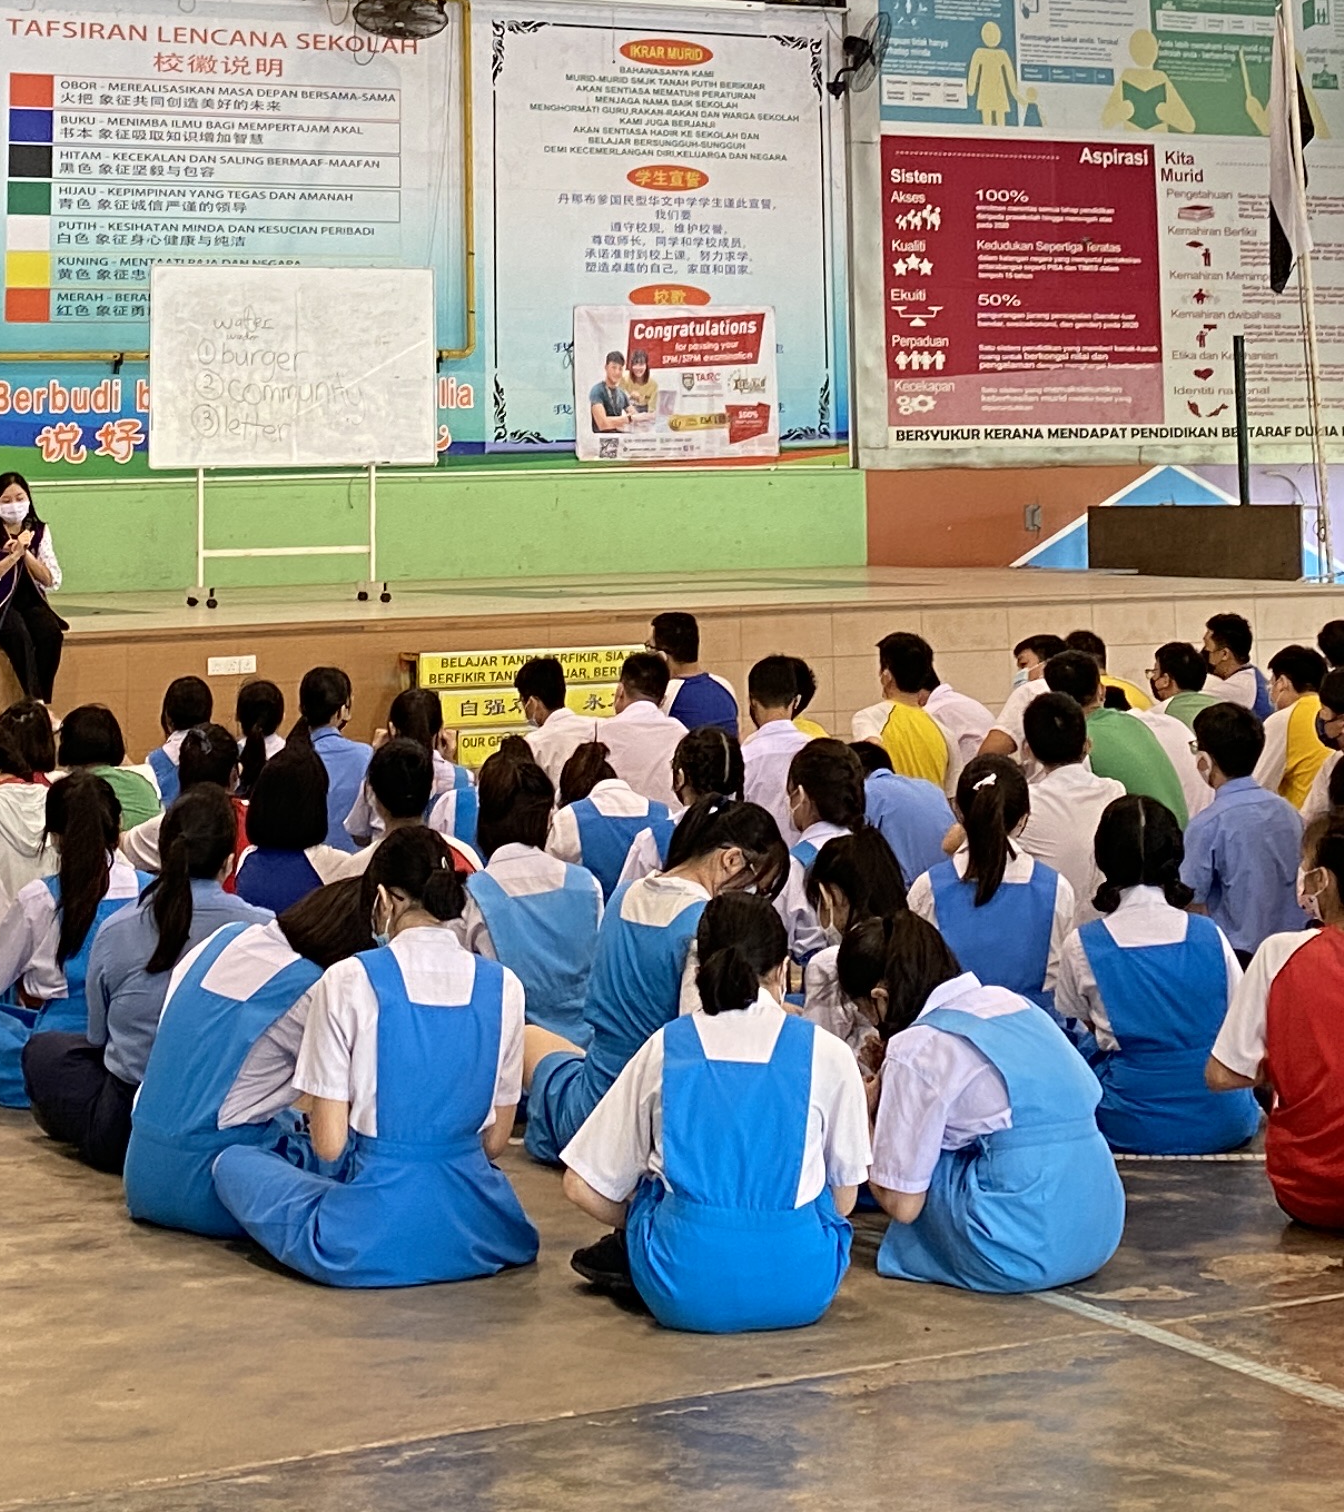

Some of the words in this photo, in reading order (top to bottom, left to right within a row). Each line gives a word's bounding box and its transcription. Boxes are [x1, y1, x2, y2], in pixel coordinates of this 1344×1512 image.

[9, 17, 148, 42] TAFSIRAN
[158, 25, 287, 48] LENCANA
[297, 33, 418, 55] SEKOLAH
[630, 45, 664, 60] IKRAR
[667, 47, 704, 63] MURID
[154, 52, 283, 77] 校徽说明
[60, 115, 95, 125] BUKU
[59, 149, 101, 161] HITAM
[112, 151, 186, 163] KECEKALAN
[1079, 147, 1148, 168] Aspirasi
[1165, 150, 1194, 165] Kita
[891, 168, 942, 184] Sistem
[1160, 167, 1203, 182] Murid
[107, 186, 186, 198] KEPIMPINAN
[298, 191, 354, 202] AMANAH
[890, 190, 925, 203] Akses
[975, 189, 1029, 202] 100%
[891, 239, 925, 252] Kualiti
[890, 288, 926, 301] Ekuiti
[978, 294, 1021, 306] 50%
[633, 319, 756, 341] Congratulations
[891, 334, 949, 349] Perpaduan
[221, 342, 307, 383] burger
[225, 405, 291, 443] letter
[896, 427, 981, 442] BERSYUKUR
[984, 427, 1044, 441] KERANA
[1048, 426, 1128, 440] MENDAPAT
[1131, 426, 1218, 440] PENDIDIKAN
[441, 655, 498, 669] BELAJAR
[429, 671, 486, 685] BERFIKIR
